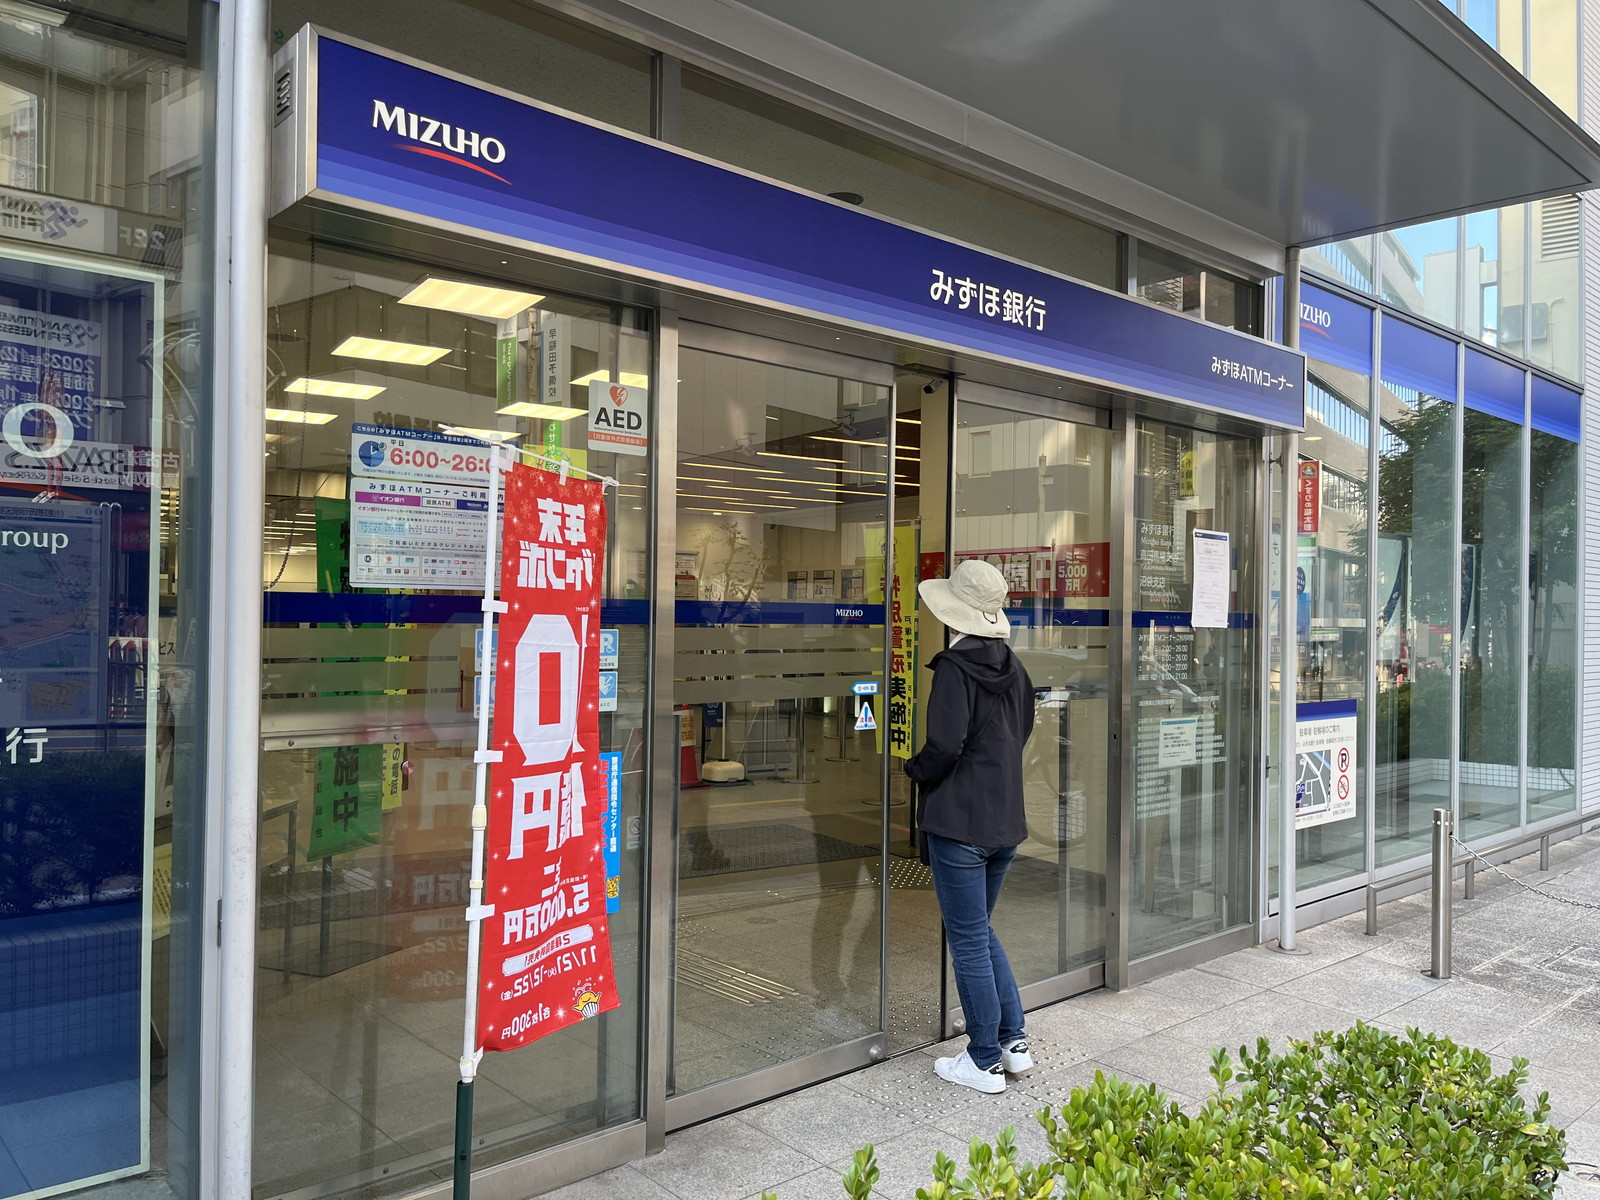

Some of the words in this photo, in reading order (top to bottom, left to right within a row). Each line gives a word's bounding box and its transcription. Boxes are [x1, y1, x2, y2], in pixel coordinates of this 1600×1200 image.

[372, 99, 506, 164] MIZUHO
[930, 268, 1047, 331] みずほ銀行
[1299, 302, 1331, 328] IZUHO
[1211, 356, 1294, 391] みずほATMコーナー
[594, 407, 643, 431] AED
[390, 439, 405, 447] 平日
[390, 447, 506, 476] 6:00~26:
[368, 482, 504, 501] みずほATMコーナーご利用内
[378, 495, 405, 505] イオン銀行
[1057, 564, 1088, 579] 5,000
[835, 608, 864, 618] MIZUHO
[6, 727, 49, 764] 行
